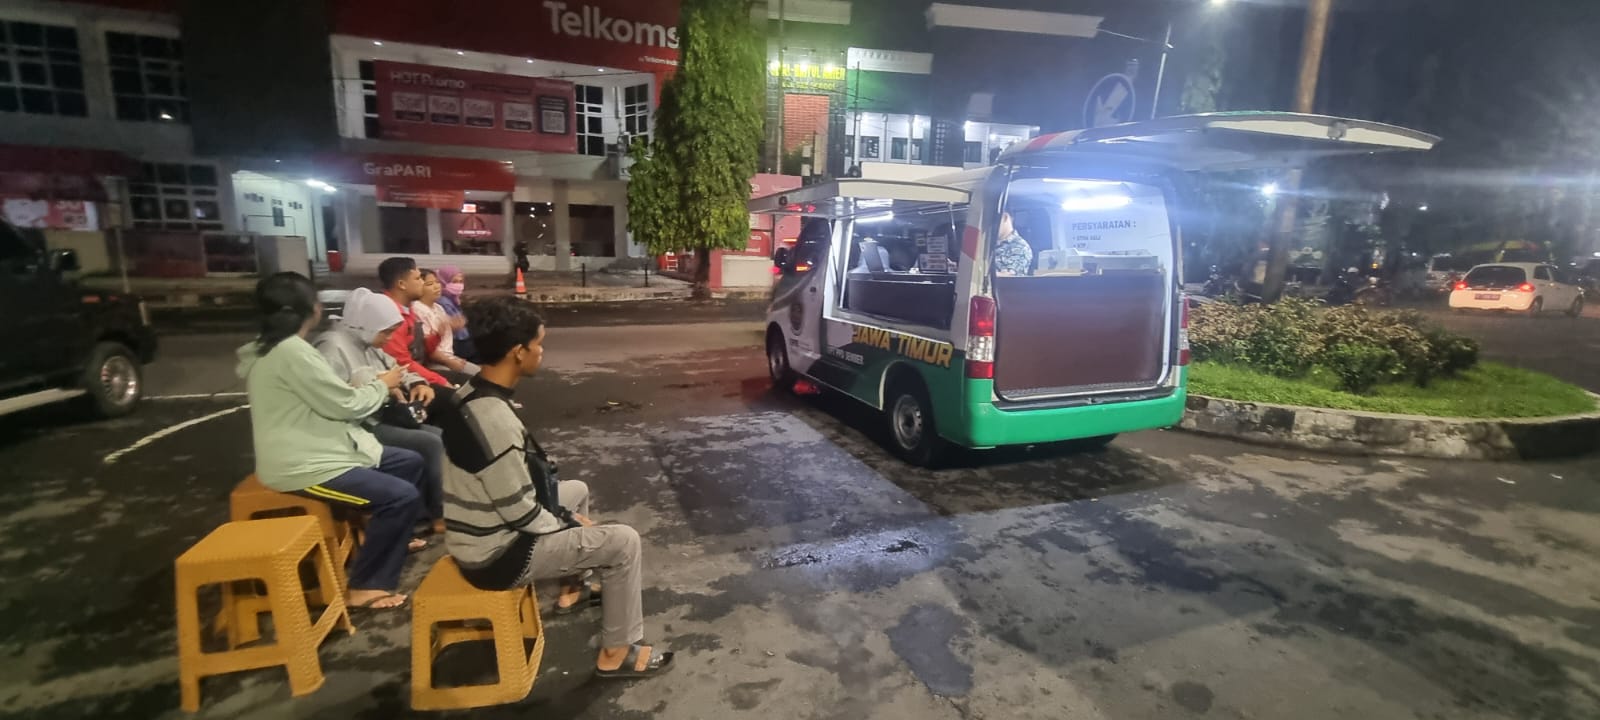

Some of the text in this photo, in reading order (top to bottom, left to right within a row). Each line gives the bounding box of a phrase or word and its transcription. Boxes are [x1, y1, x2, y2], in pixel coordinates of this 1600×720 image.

[363, 162, 432, 178] GraPARI
[1072, 220, 1131, 231] PERSYARATAN
[898, 333, 954, 369] TIMUR
